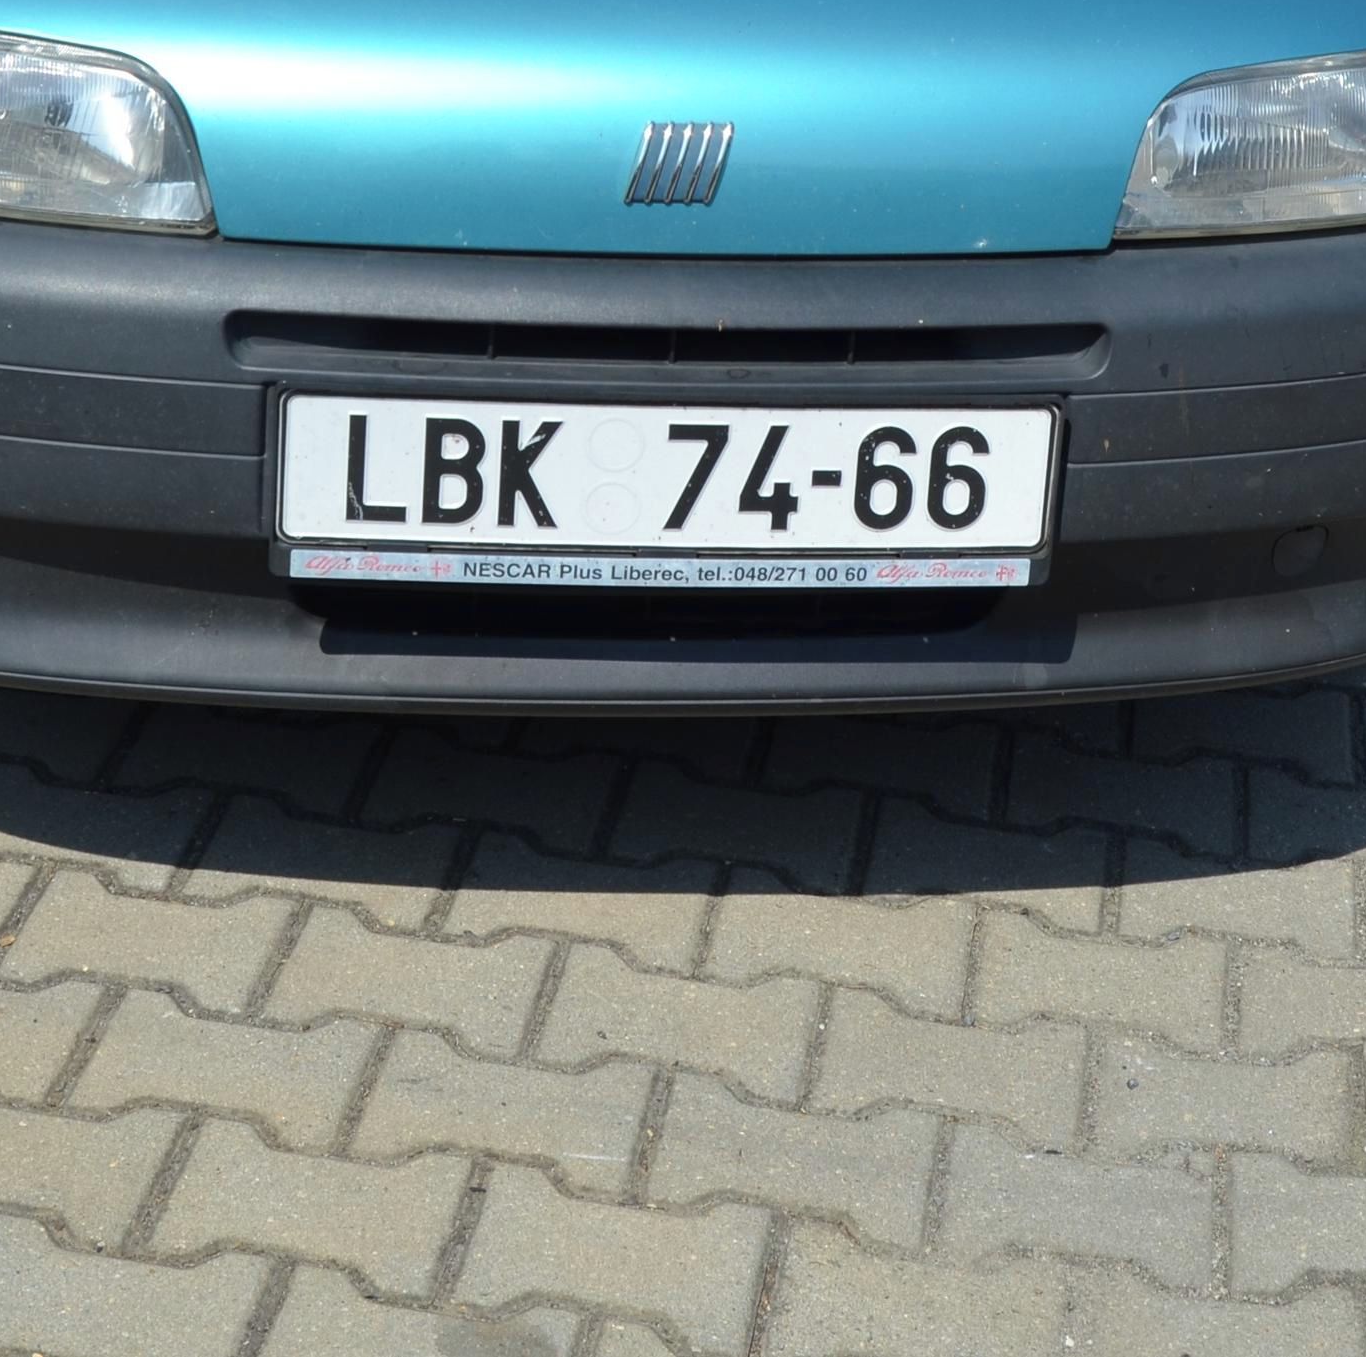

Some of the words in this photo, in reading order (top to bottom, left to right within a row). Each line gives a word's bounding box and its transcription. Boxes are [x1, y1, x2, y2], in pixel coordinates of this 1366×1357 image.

[344, 413, 564, 529] LBK
[662, 422, 991, 532] 74-66
[357, 555, 423, 573] Romeo
[463, 562, 551, 579] NESCAR
[559, 564, 603, 580] Plus
[611, 565, 689, 584] Liberec,
[698, 566, 806, 582] tel.:048/271
[815, 567, 837, 582] 00
[845, 567, 867, 582] 60
